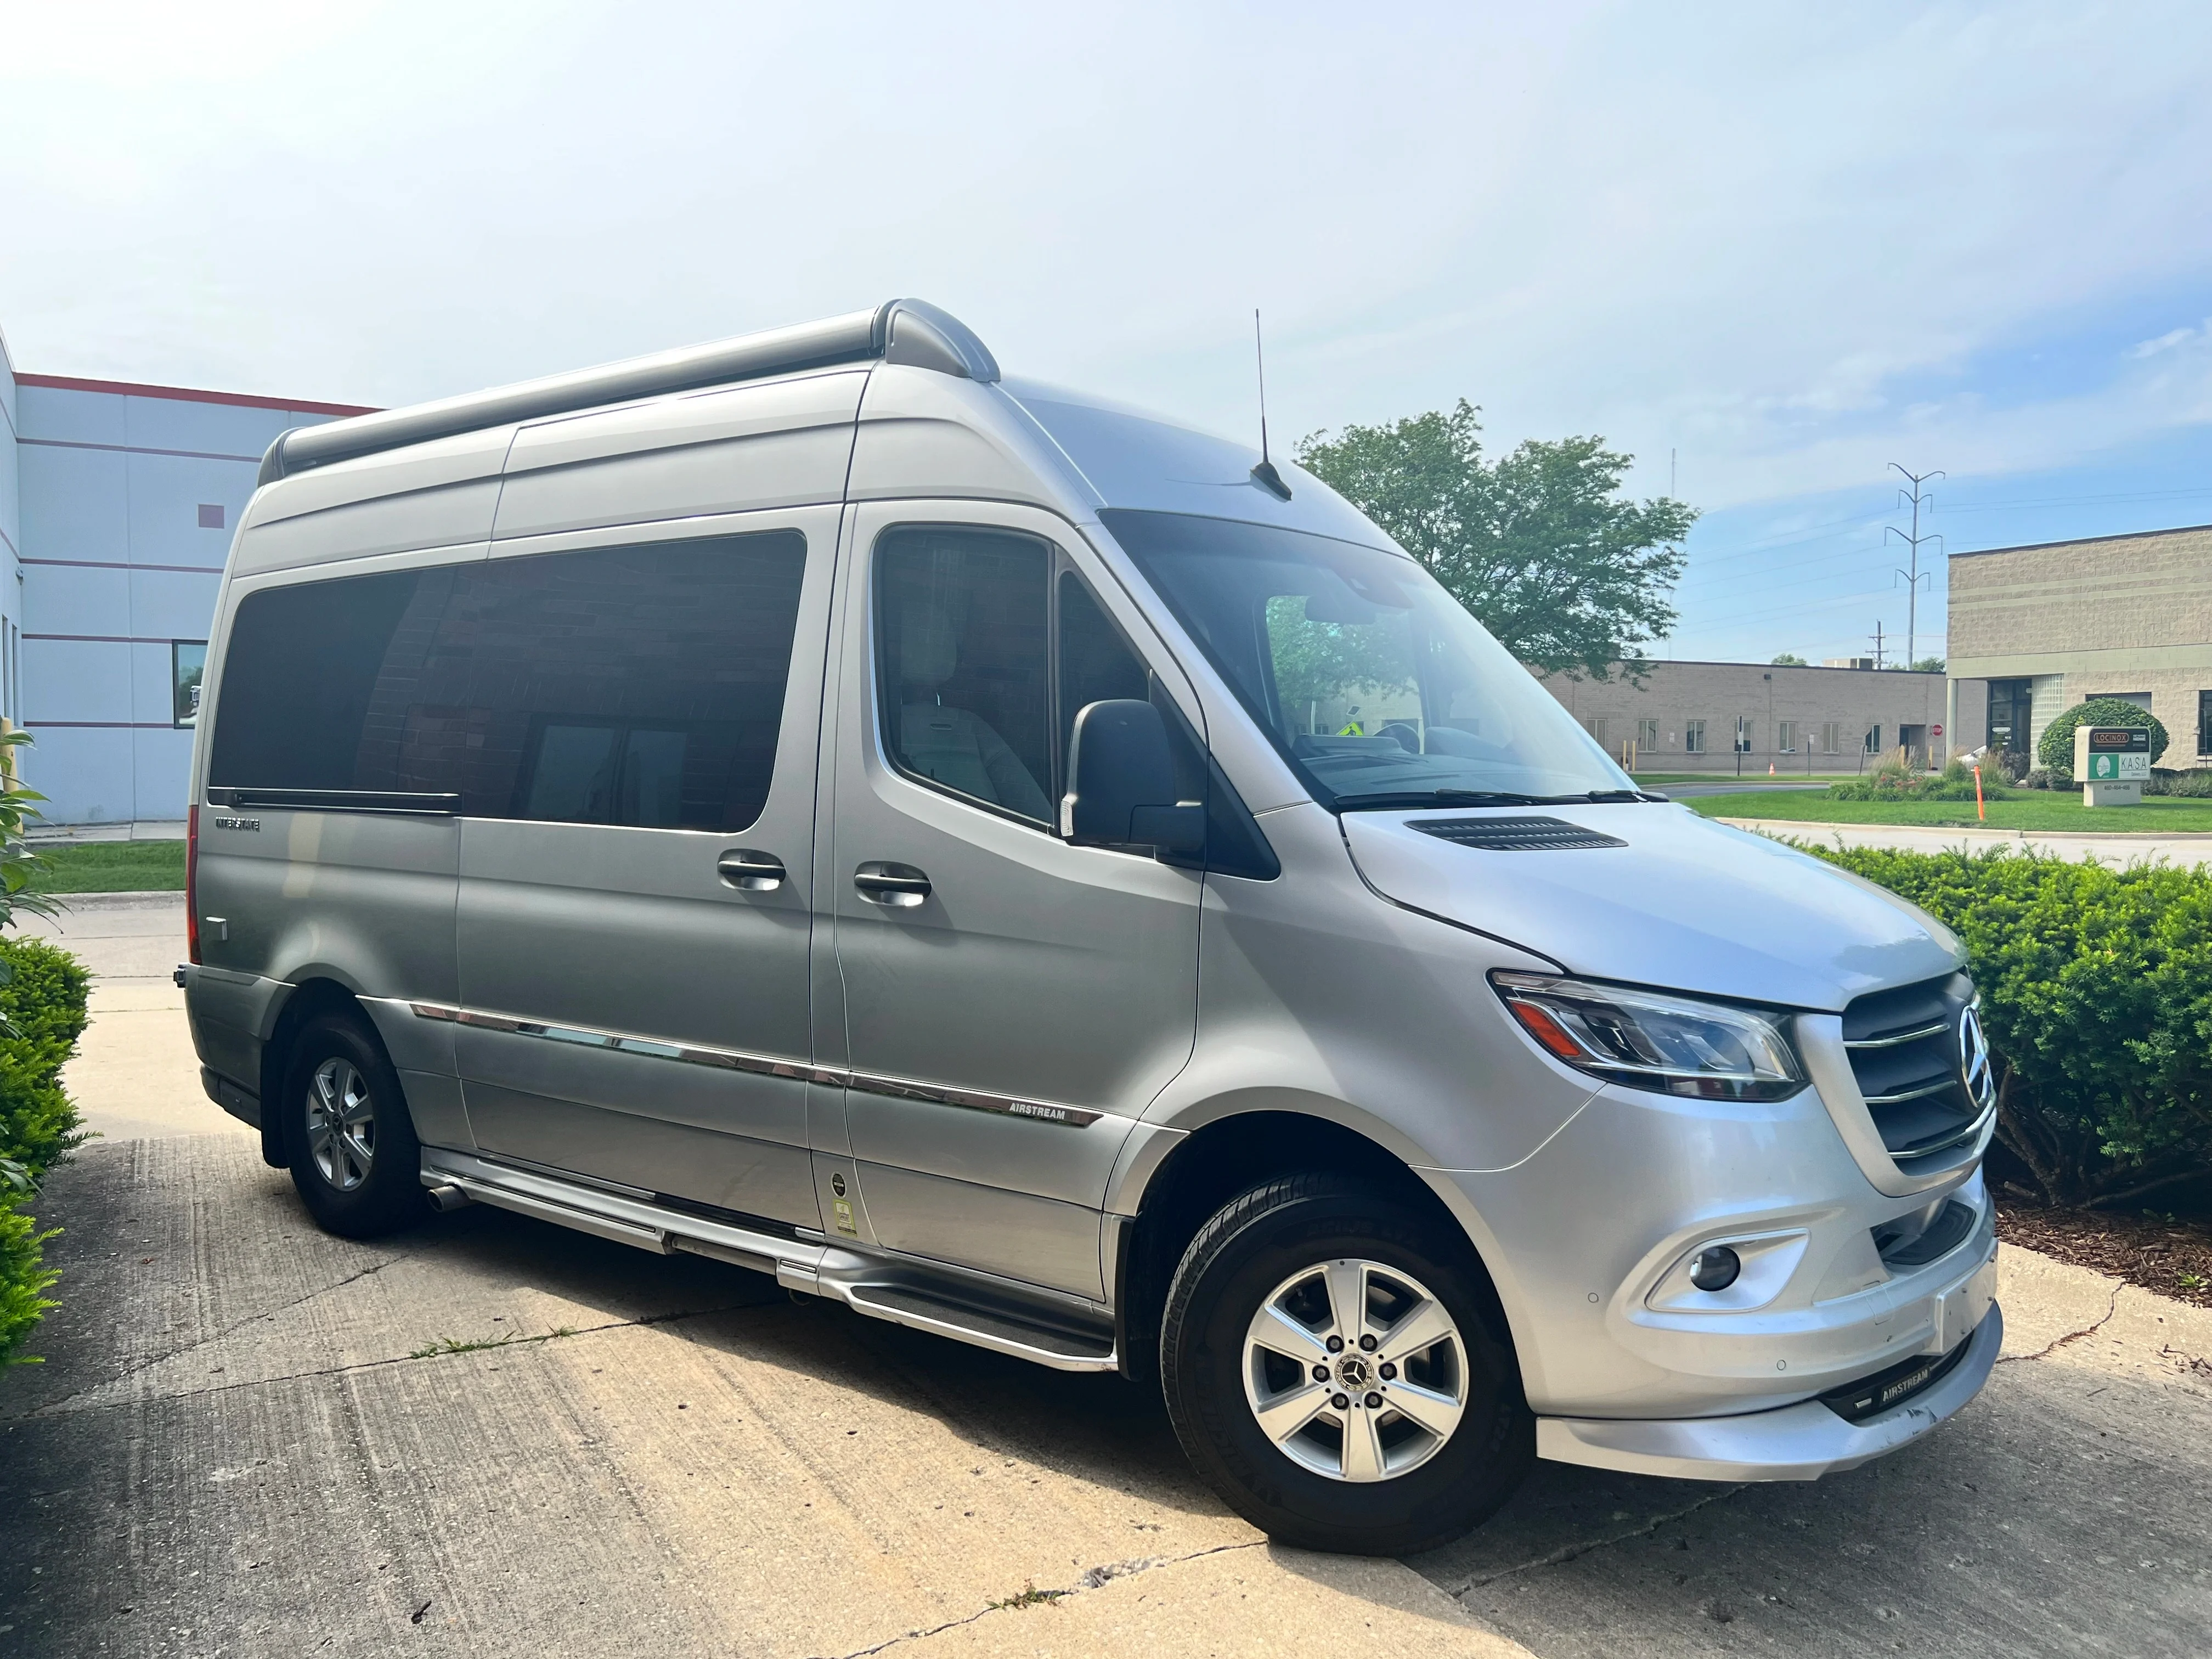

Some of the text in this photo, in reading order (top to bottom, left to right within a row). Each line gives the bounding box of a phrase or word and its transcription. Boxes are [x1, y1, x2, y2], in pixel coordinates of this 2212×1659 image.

[2121, 757, 2147, 769] KASA
[216, 816, 259, 830] INTERSTATE
[1009, 1102, 1065, 1120] AIRSTREAM
[1882, 1369, 1928, 1402] AIRSTREAM
